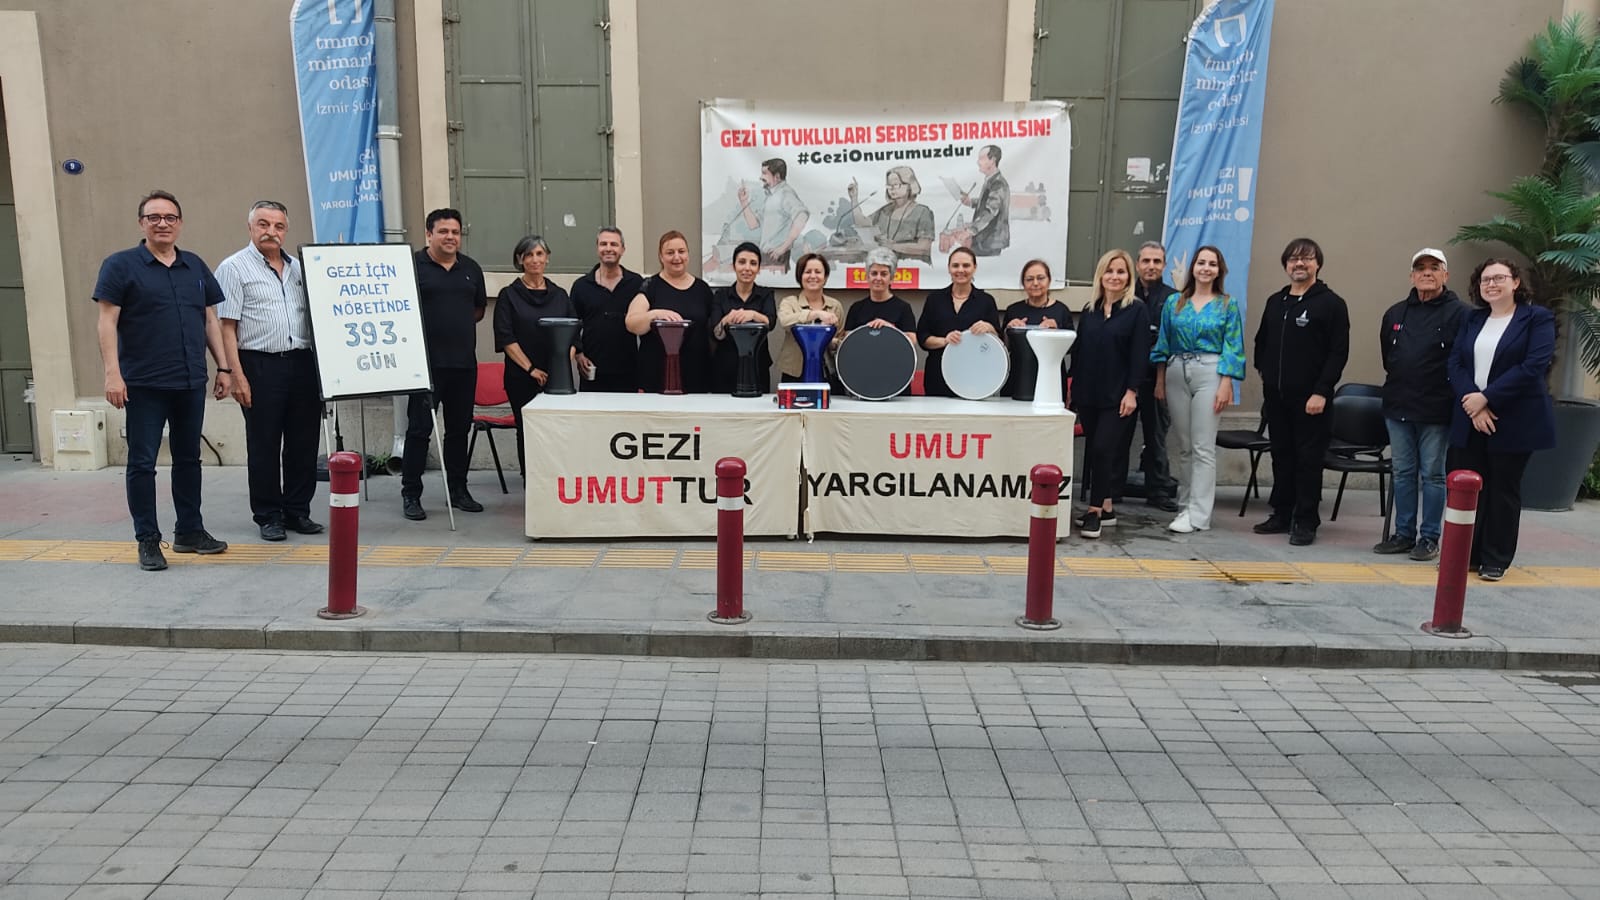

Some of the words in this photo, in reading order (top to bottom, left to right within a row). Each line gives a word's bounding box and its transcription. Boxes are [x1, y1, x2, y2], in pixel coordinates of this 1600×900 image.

[720, 123, 757, 148] GEZİ
[761, 126, 871, 147] TUTUKLULARI
[876, 123, 948, 143] SERBEST
[952, 119, 1051, 140] BIRAKILSIN!
[797, 144, 974, 165] #GeziOnurumuzdur
[326, 263, 361, 278] GEZİ
[366, 262, 397, 280] İÇİN
[339, 283, 390, 297] ADALET
[332, 299, 411, 316] NÖBETİNDE
[344, 320, 408, 347] 393.
[356, 351, 397, 371] GÜN
[609, 426, 701, 461] GEZİ
[889, 432, 992, 460] UMUT
[807, 472, 1071, 500] YARGILANAMZ
